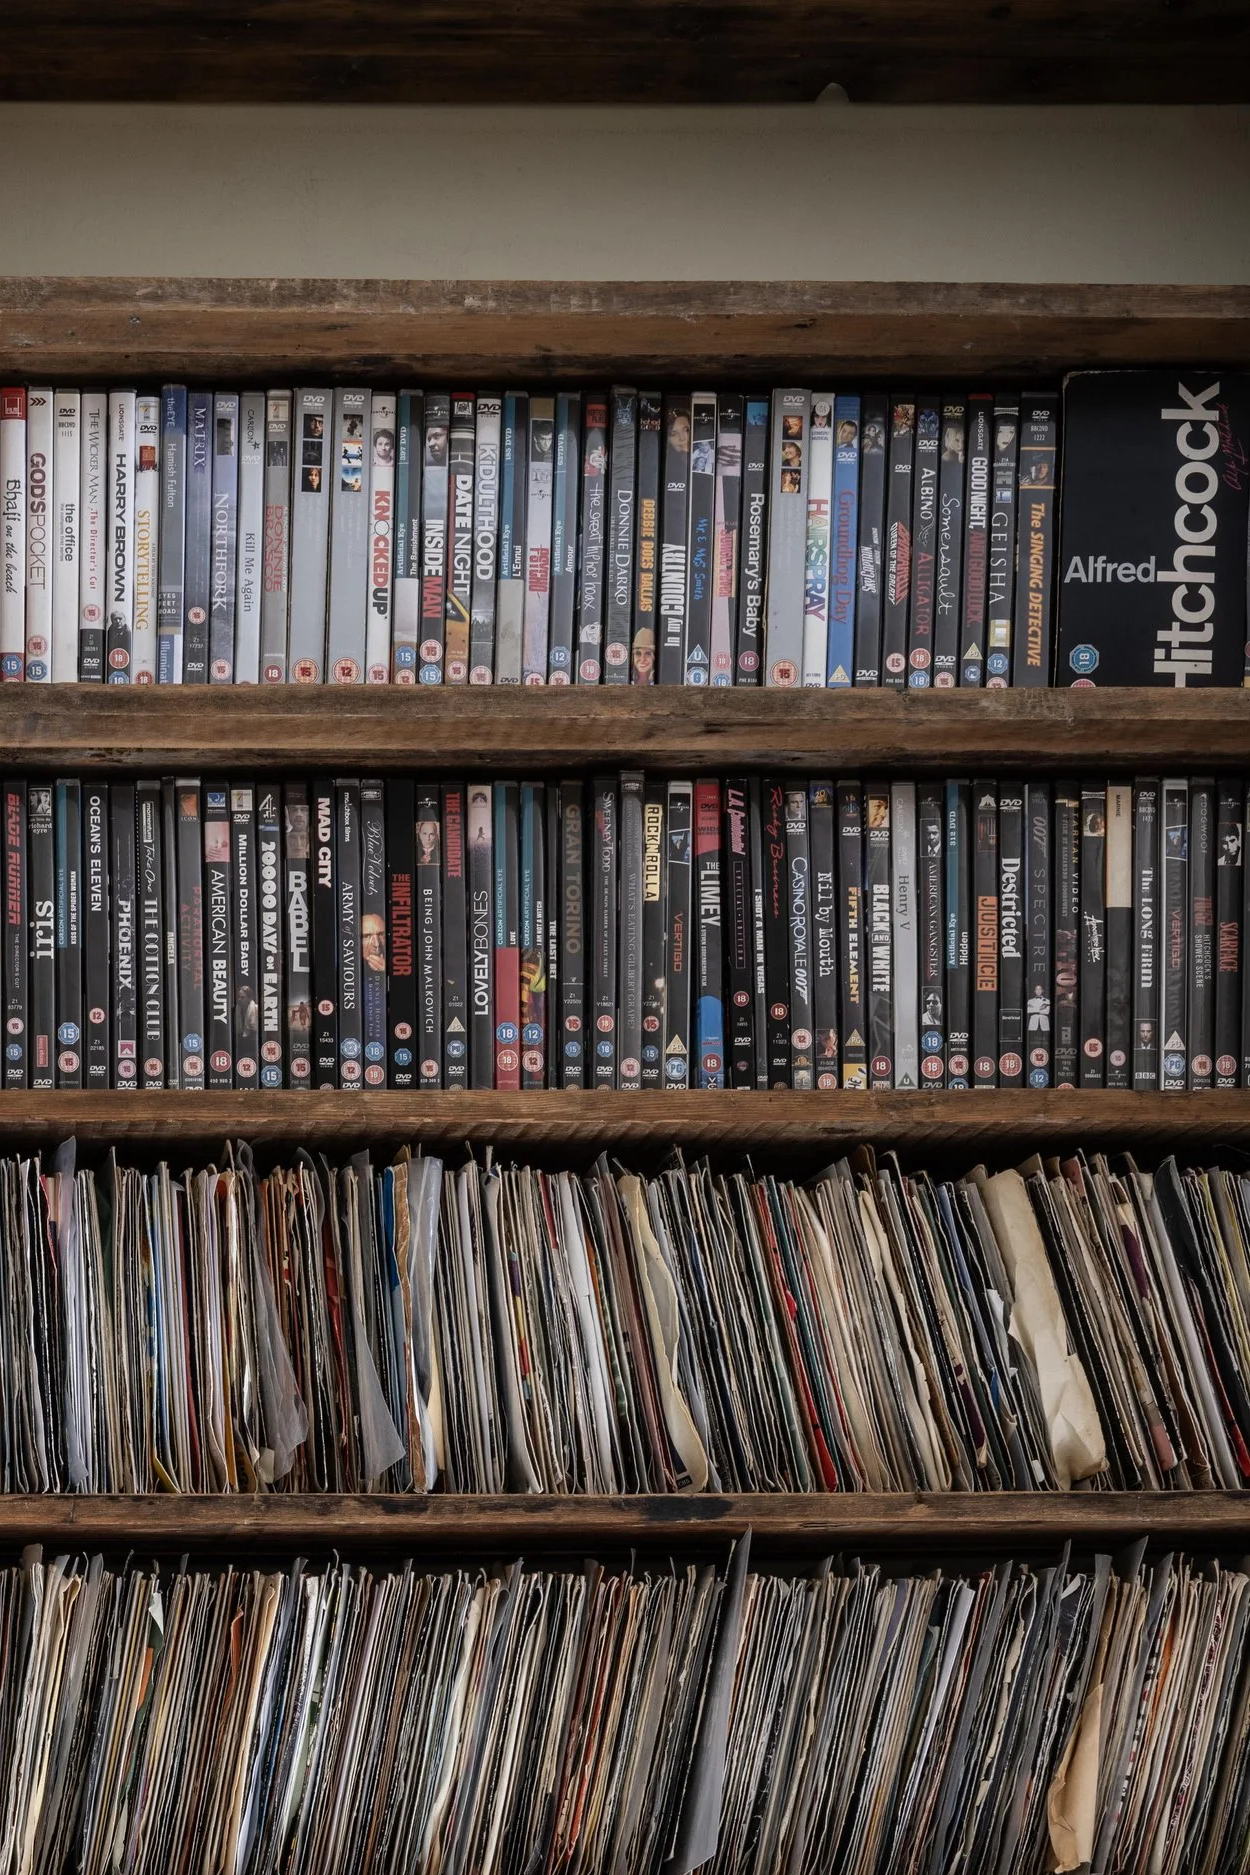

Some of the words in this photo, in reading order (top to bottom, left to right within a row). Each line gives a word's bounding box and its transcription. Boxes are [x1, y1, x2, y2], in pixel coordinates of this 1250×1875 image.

[167, 444, 176, 477] Hamish
[64, 504, 74, 524] the
[115, 453, 126, 524] HARRY
[167, 480, 176, 507] Fulton
[455, 475, 471, 528] DATE
[640, 499, 655, 536] DEBBIE
[745, 493, 764, 590] Rosemary's
[835, 490, 855, 585] Groundhog
[1031, 503, 1045, 528] The
[64, 527, 75, 561] office
[114, 526, 125, 602] BROWN
[212, 493, 229, 611] NORTHFORK
[454, 532, 471, 595] NIGHT
[641, 541, 654, 569] DOES
[805, 499, 828, 621] HAIRSPRAY
[1029, 531, 1044, 590] SINGING
[1064, 556, 1156, 583] Alfred
[136, 510, 150, 631] STORYTELLING
[640, 573, 653, 612] DALLAS
[743, 595, 760, 638] Baby
[830, 590, 852, 625] Day
[1027, 592, 1042, 667] DETECTIVE
[90, 796, 101, 853] OCEAN'S
[318, 798, 331, 841] MAD
[566, 804, 580, 864] GRAN
[91, 859, 101, 911] ELEVEN
[318, 847, 332, 888] CITY
[818, 872, 831, 902] Nil
[211, 870, 226, 953] AMERICAN
[566, 872, 580, 954] TORINO
[815, 907, 830, 923] by
[848, 887, 858, 928] FIFTH
[897, 875, 910, 916] Henry
[1001, 858, 1020, 958] Destricted
[392, 883, 411, 976] INFILTRATOR
[674, 913, 683, 971] VERTIGO
[900, 921, 910, 930] V
[978, 898, 996, 990] JUSTICE
[1220, 922, 1238, 972] SCARFACE
[818, 928, 831, 977] Mouth
[849, 933, 858, 1003] ELEMENT
[212, 959, 227, 1024] BEAUTY
